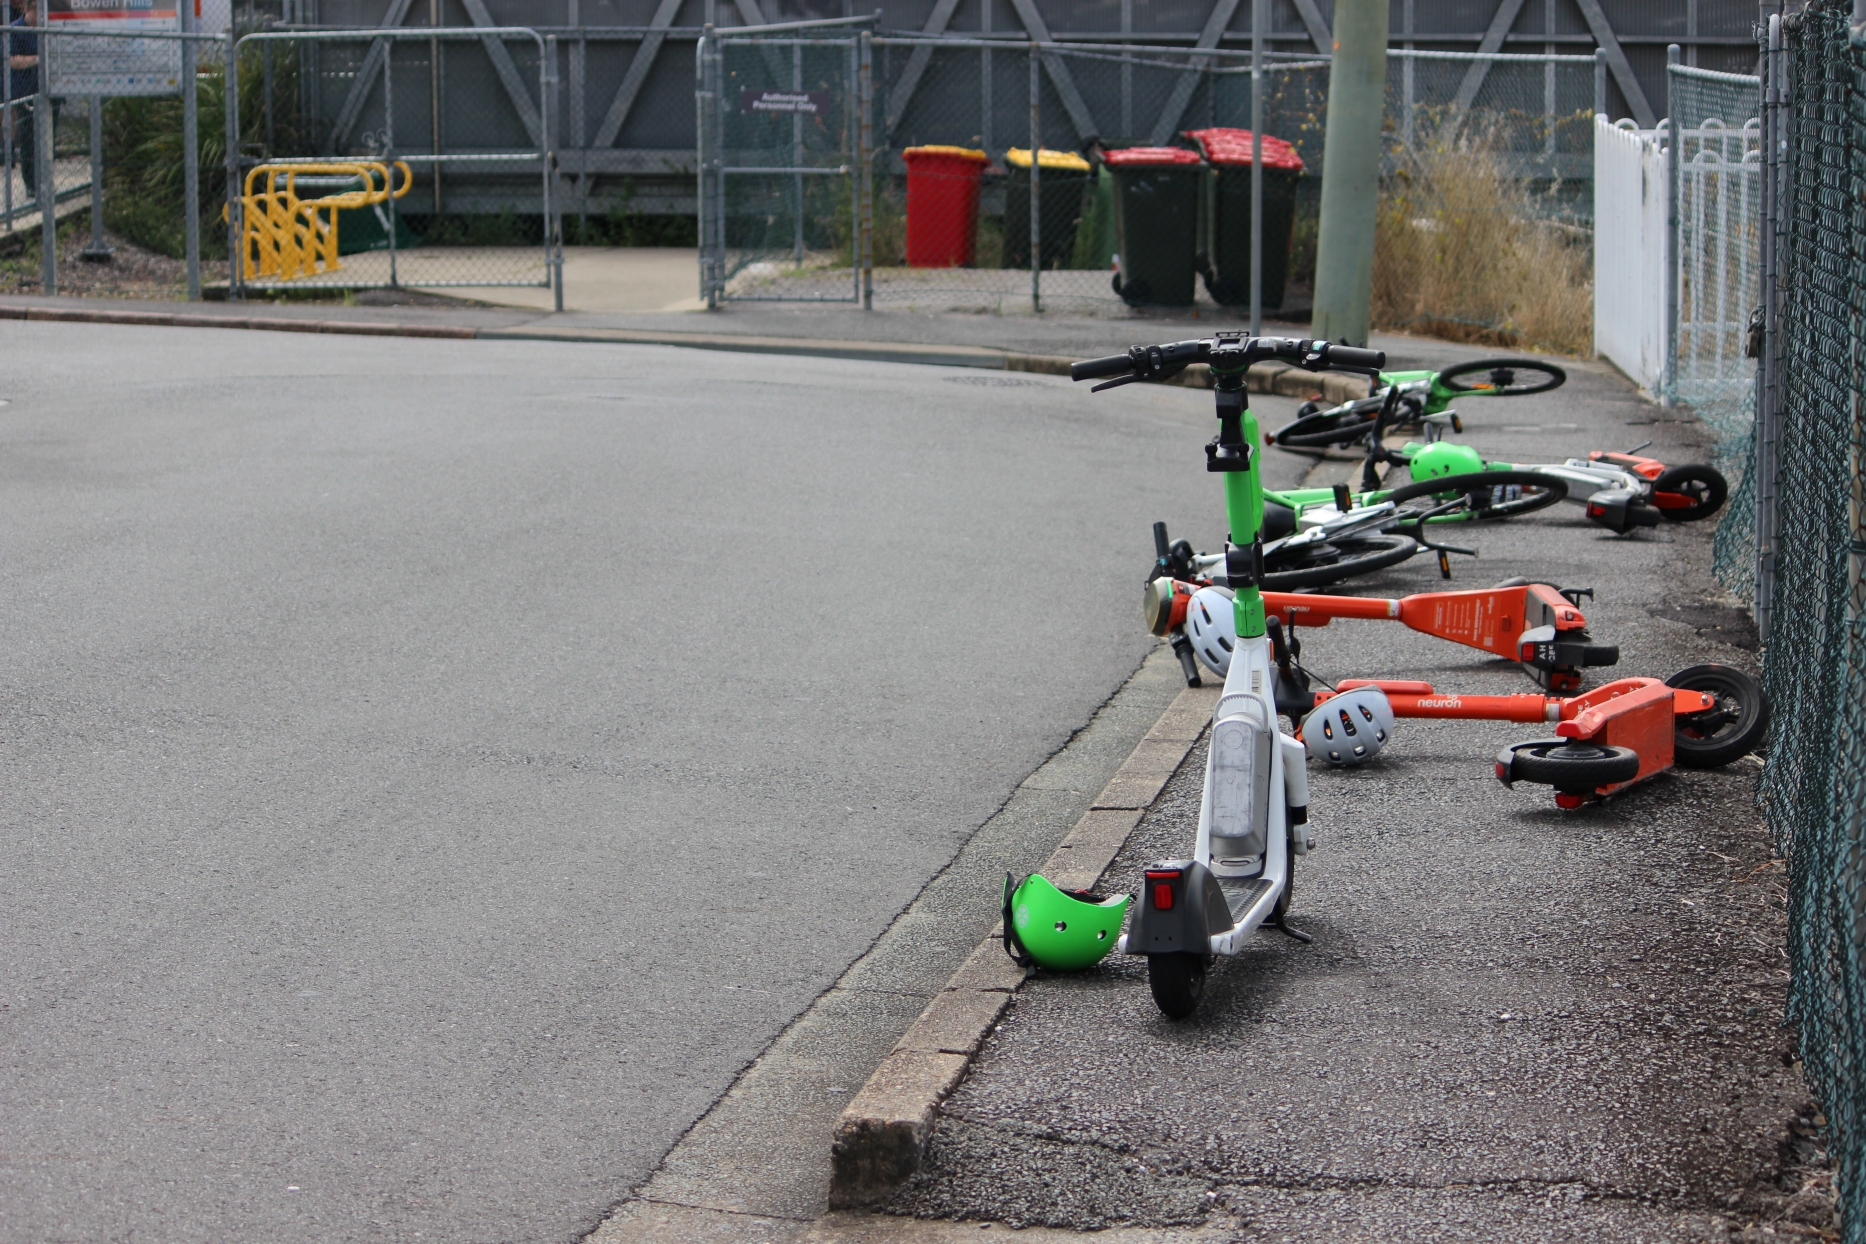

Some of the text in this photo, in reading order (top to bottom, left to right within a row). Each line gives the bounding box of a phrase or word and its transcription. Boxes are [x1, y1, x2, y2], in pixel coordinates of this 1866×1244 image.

[70, 0, 119, 9] Bowen
[762, 92, 809, 101] Authorised
[753, 101, 817, 112] Personnel Only
[1539, 644, 1547, 660] AH
[1417, 696, 1462, 708] neuron
